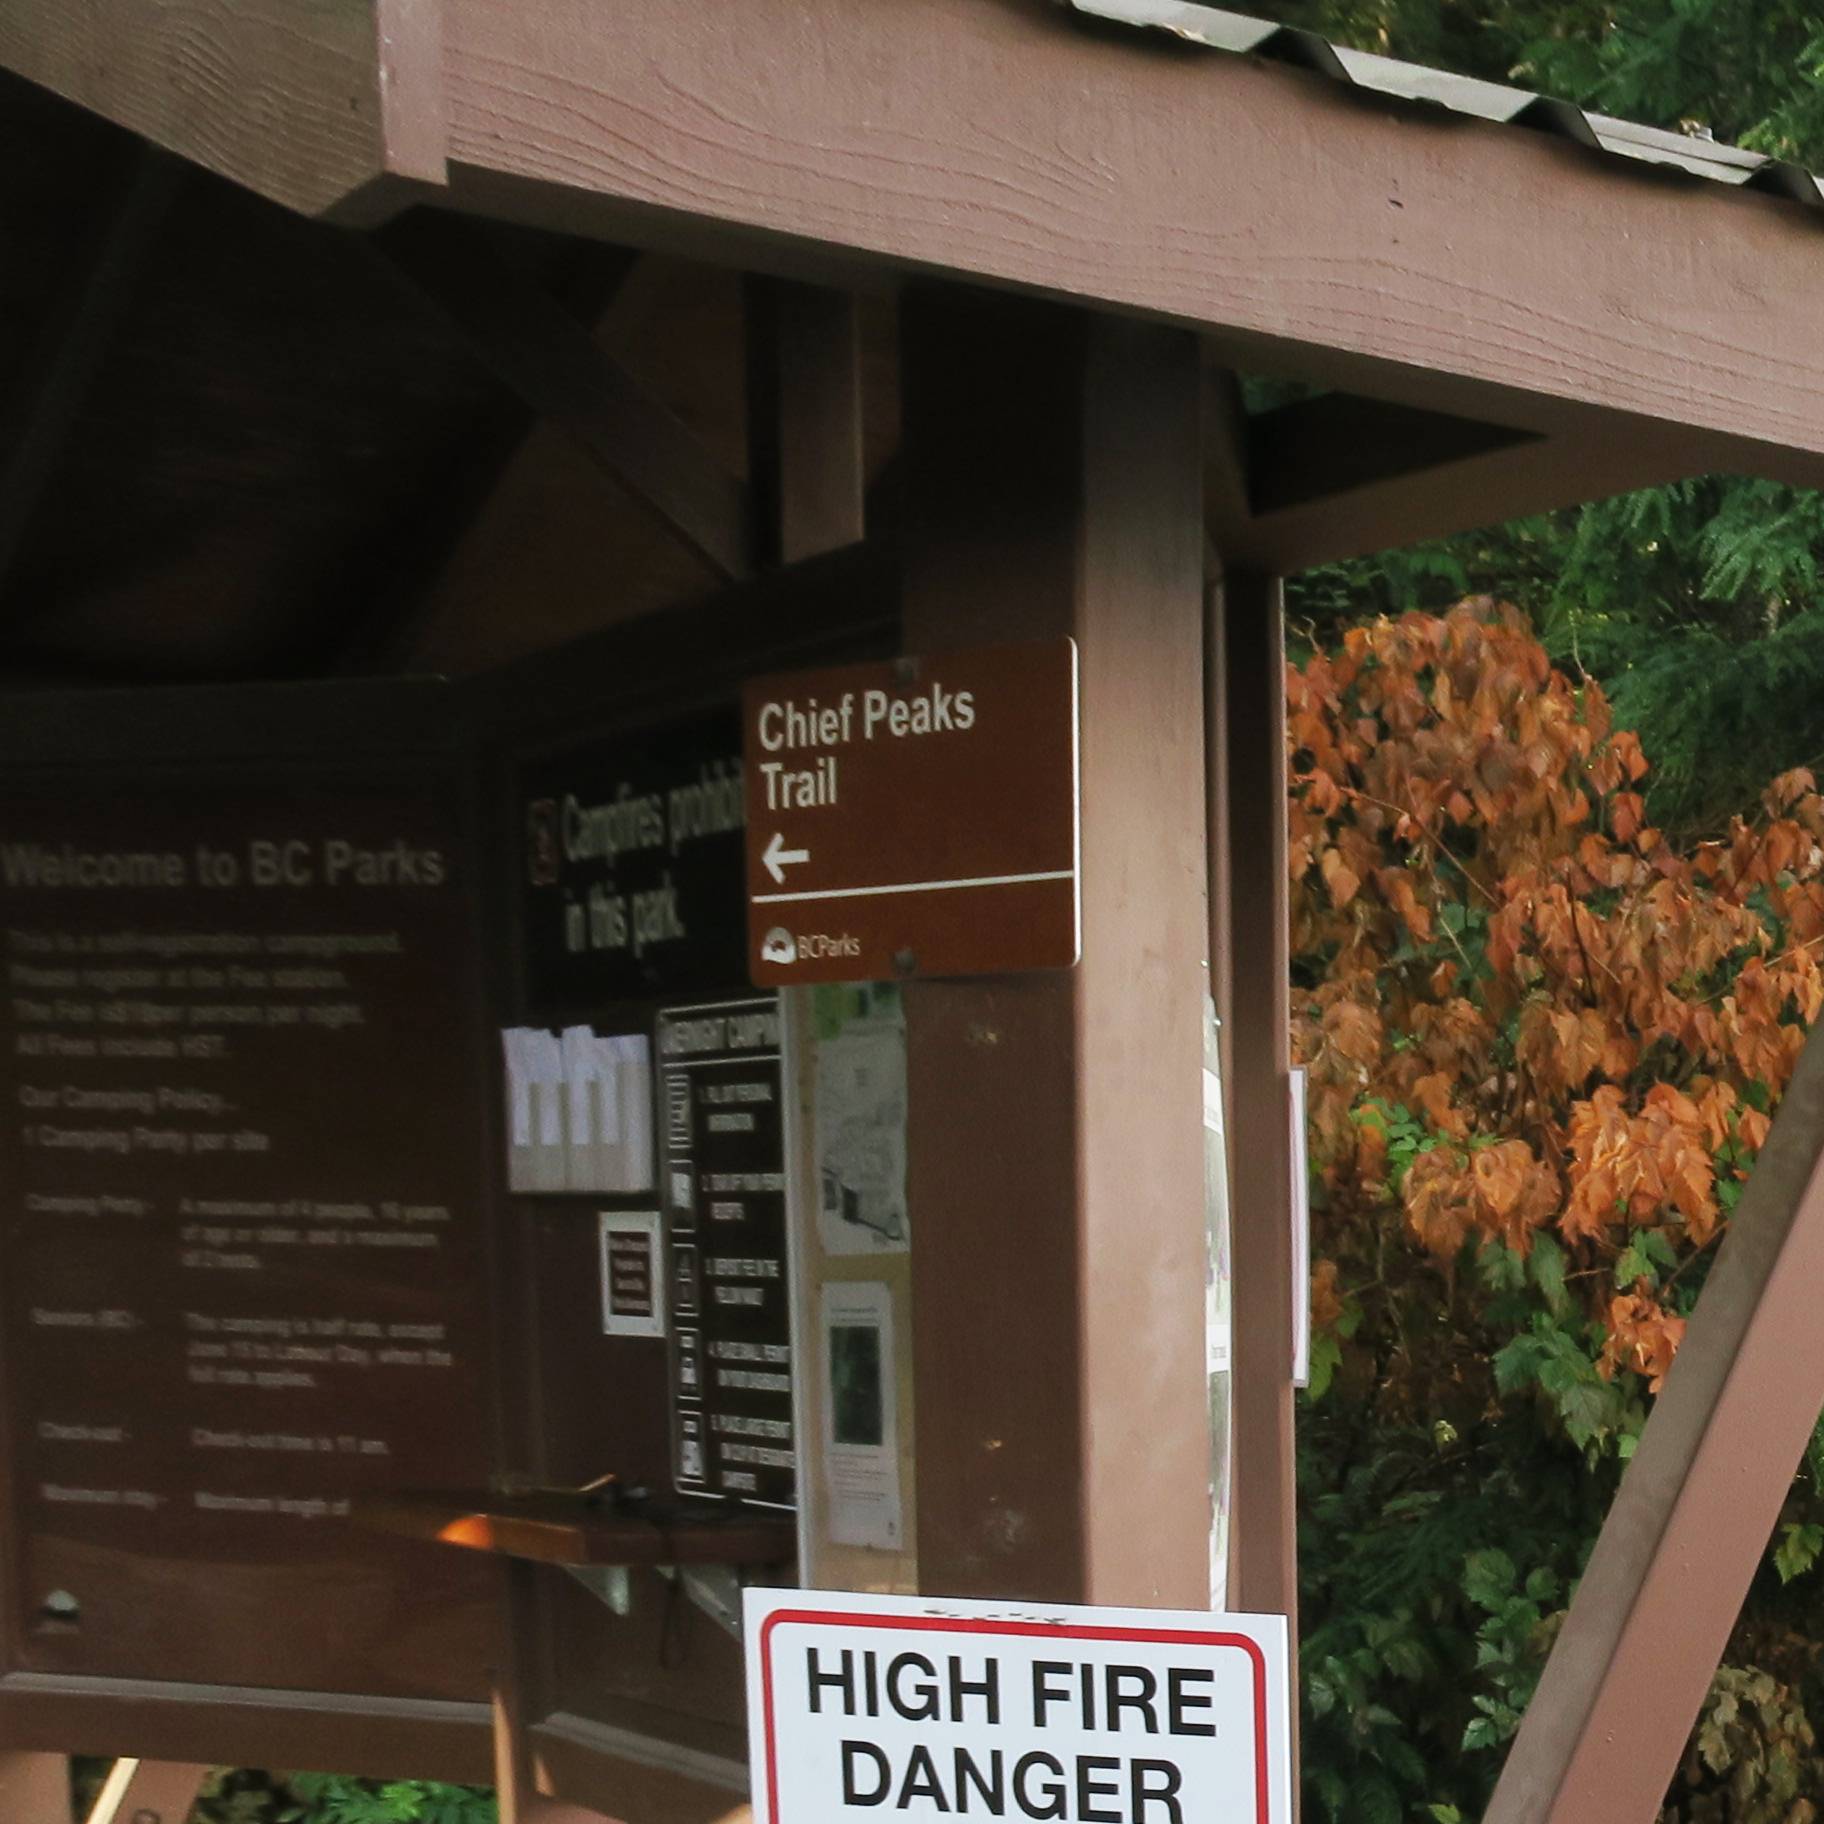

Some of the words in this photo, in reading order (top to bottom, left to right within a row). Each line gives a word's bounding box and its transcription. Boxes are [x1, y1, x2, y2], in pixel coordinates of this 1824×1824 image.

[759, 693, 854, 751] Chief
[864, 682, 975, 740] Peaks
[760, 756, 837, 810] Trail
[1, 843, 187, 887] Welcome
[195, 843, 239, 887] to
[249, 839, 312, 887] BC
[323, 838, 447, 887] Parks
[562, 887, 586, 953] in
[589, 880, 628, 948] this
[797, 933, 861, 959] BCParks
[806, 1648, 1000, 1724] HIGH
[1032, 1660, 1217, 1737] FIRE
